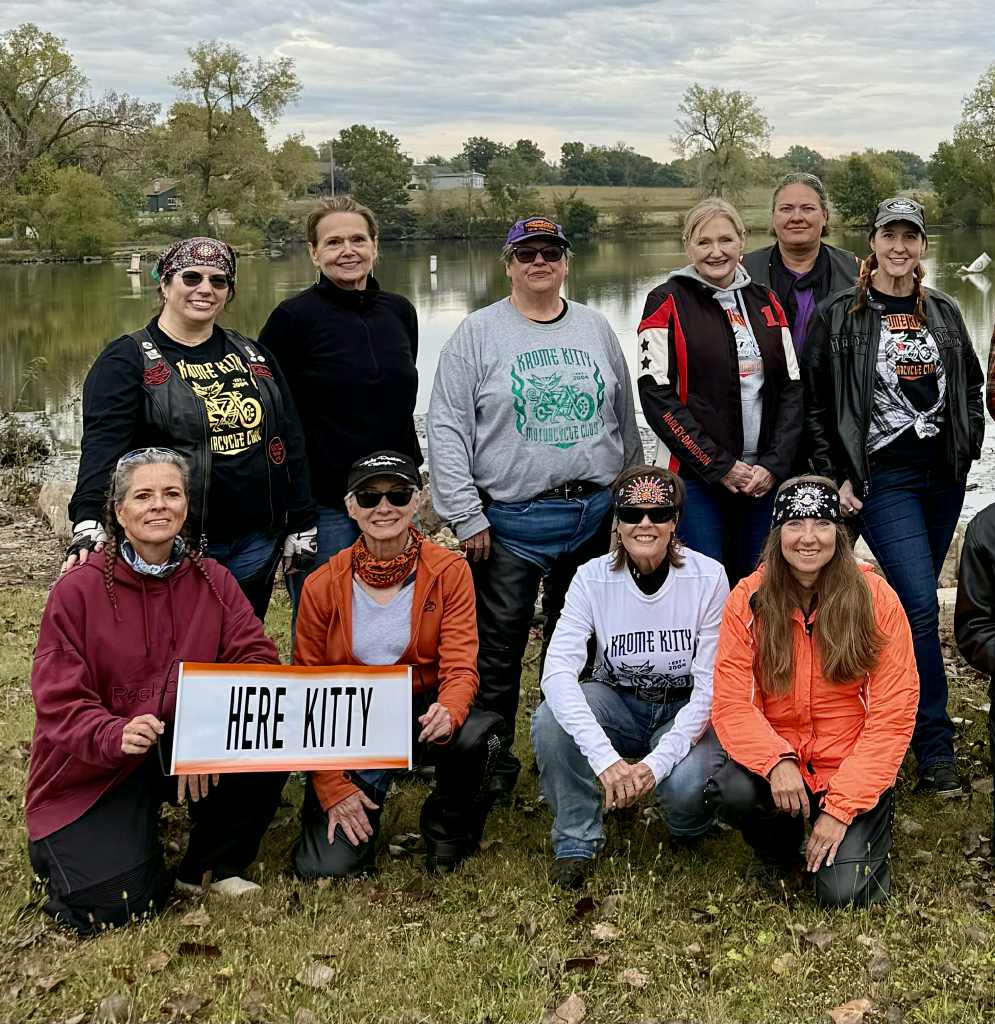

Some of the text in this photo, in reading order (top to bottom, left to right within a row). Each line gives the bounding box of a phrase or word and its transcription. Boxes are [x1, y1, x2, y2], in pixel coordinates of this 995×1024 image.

[516, 347, 591, 372] KROME KITTY
[662, 411, 712, 465] HARLEY-DAVIDSON
[610, 629, 691, 657] KROME KITTY
[226, 686, 373, 750] HERE KITTY
